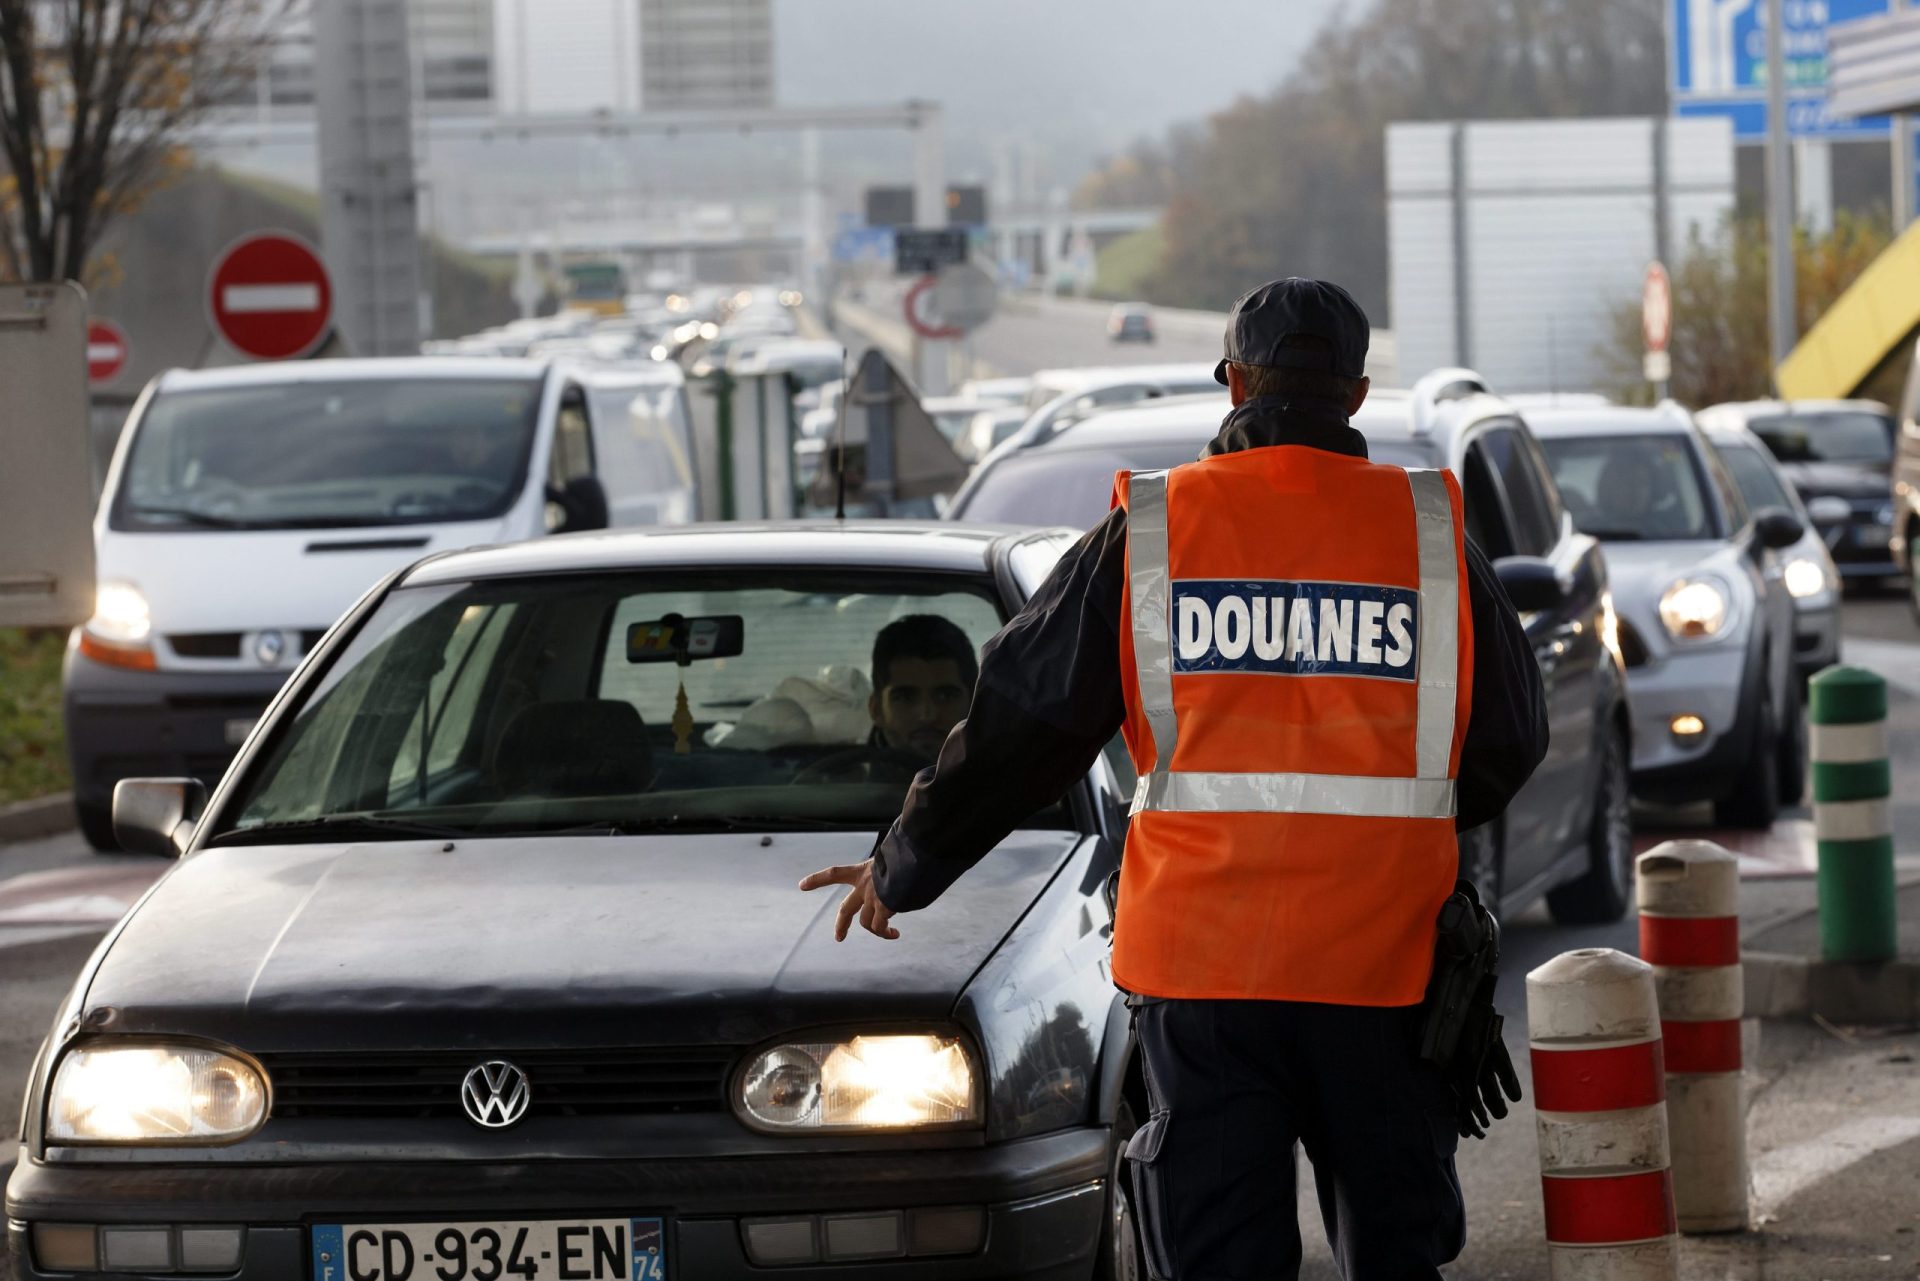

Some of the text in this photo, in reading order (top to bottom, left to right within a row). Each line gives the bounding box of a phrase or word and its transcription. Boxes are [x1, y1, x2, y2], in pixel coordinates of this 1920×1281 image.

[1178, 594, 1414, 668] DOUANES
[323, 1266, 334, 1281] F
[347, 1225, 627, 1281] CD-934-EN
[633, 1255, 663, 1281] 74
